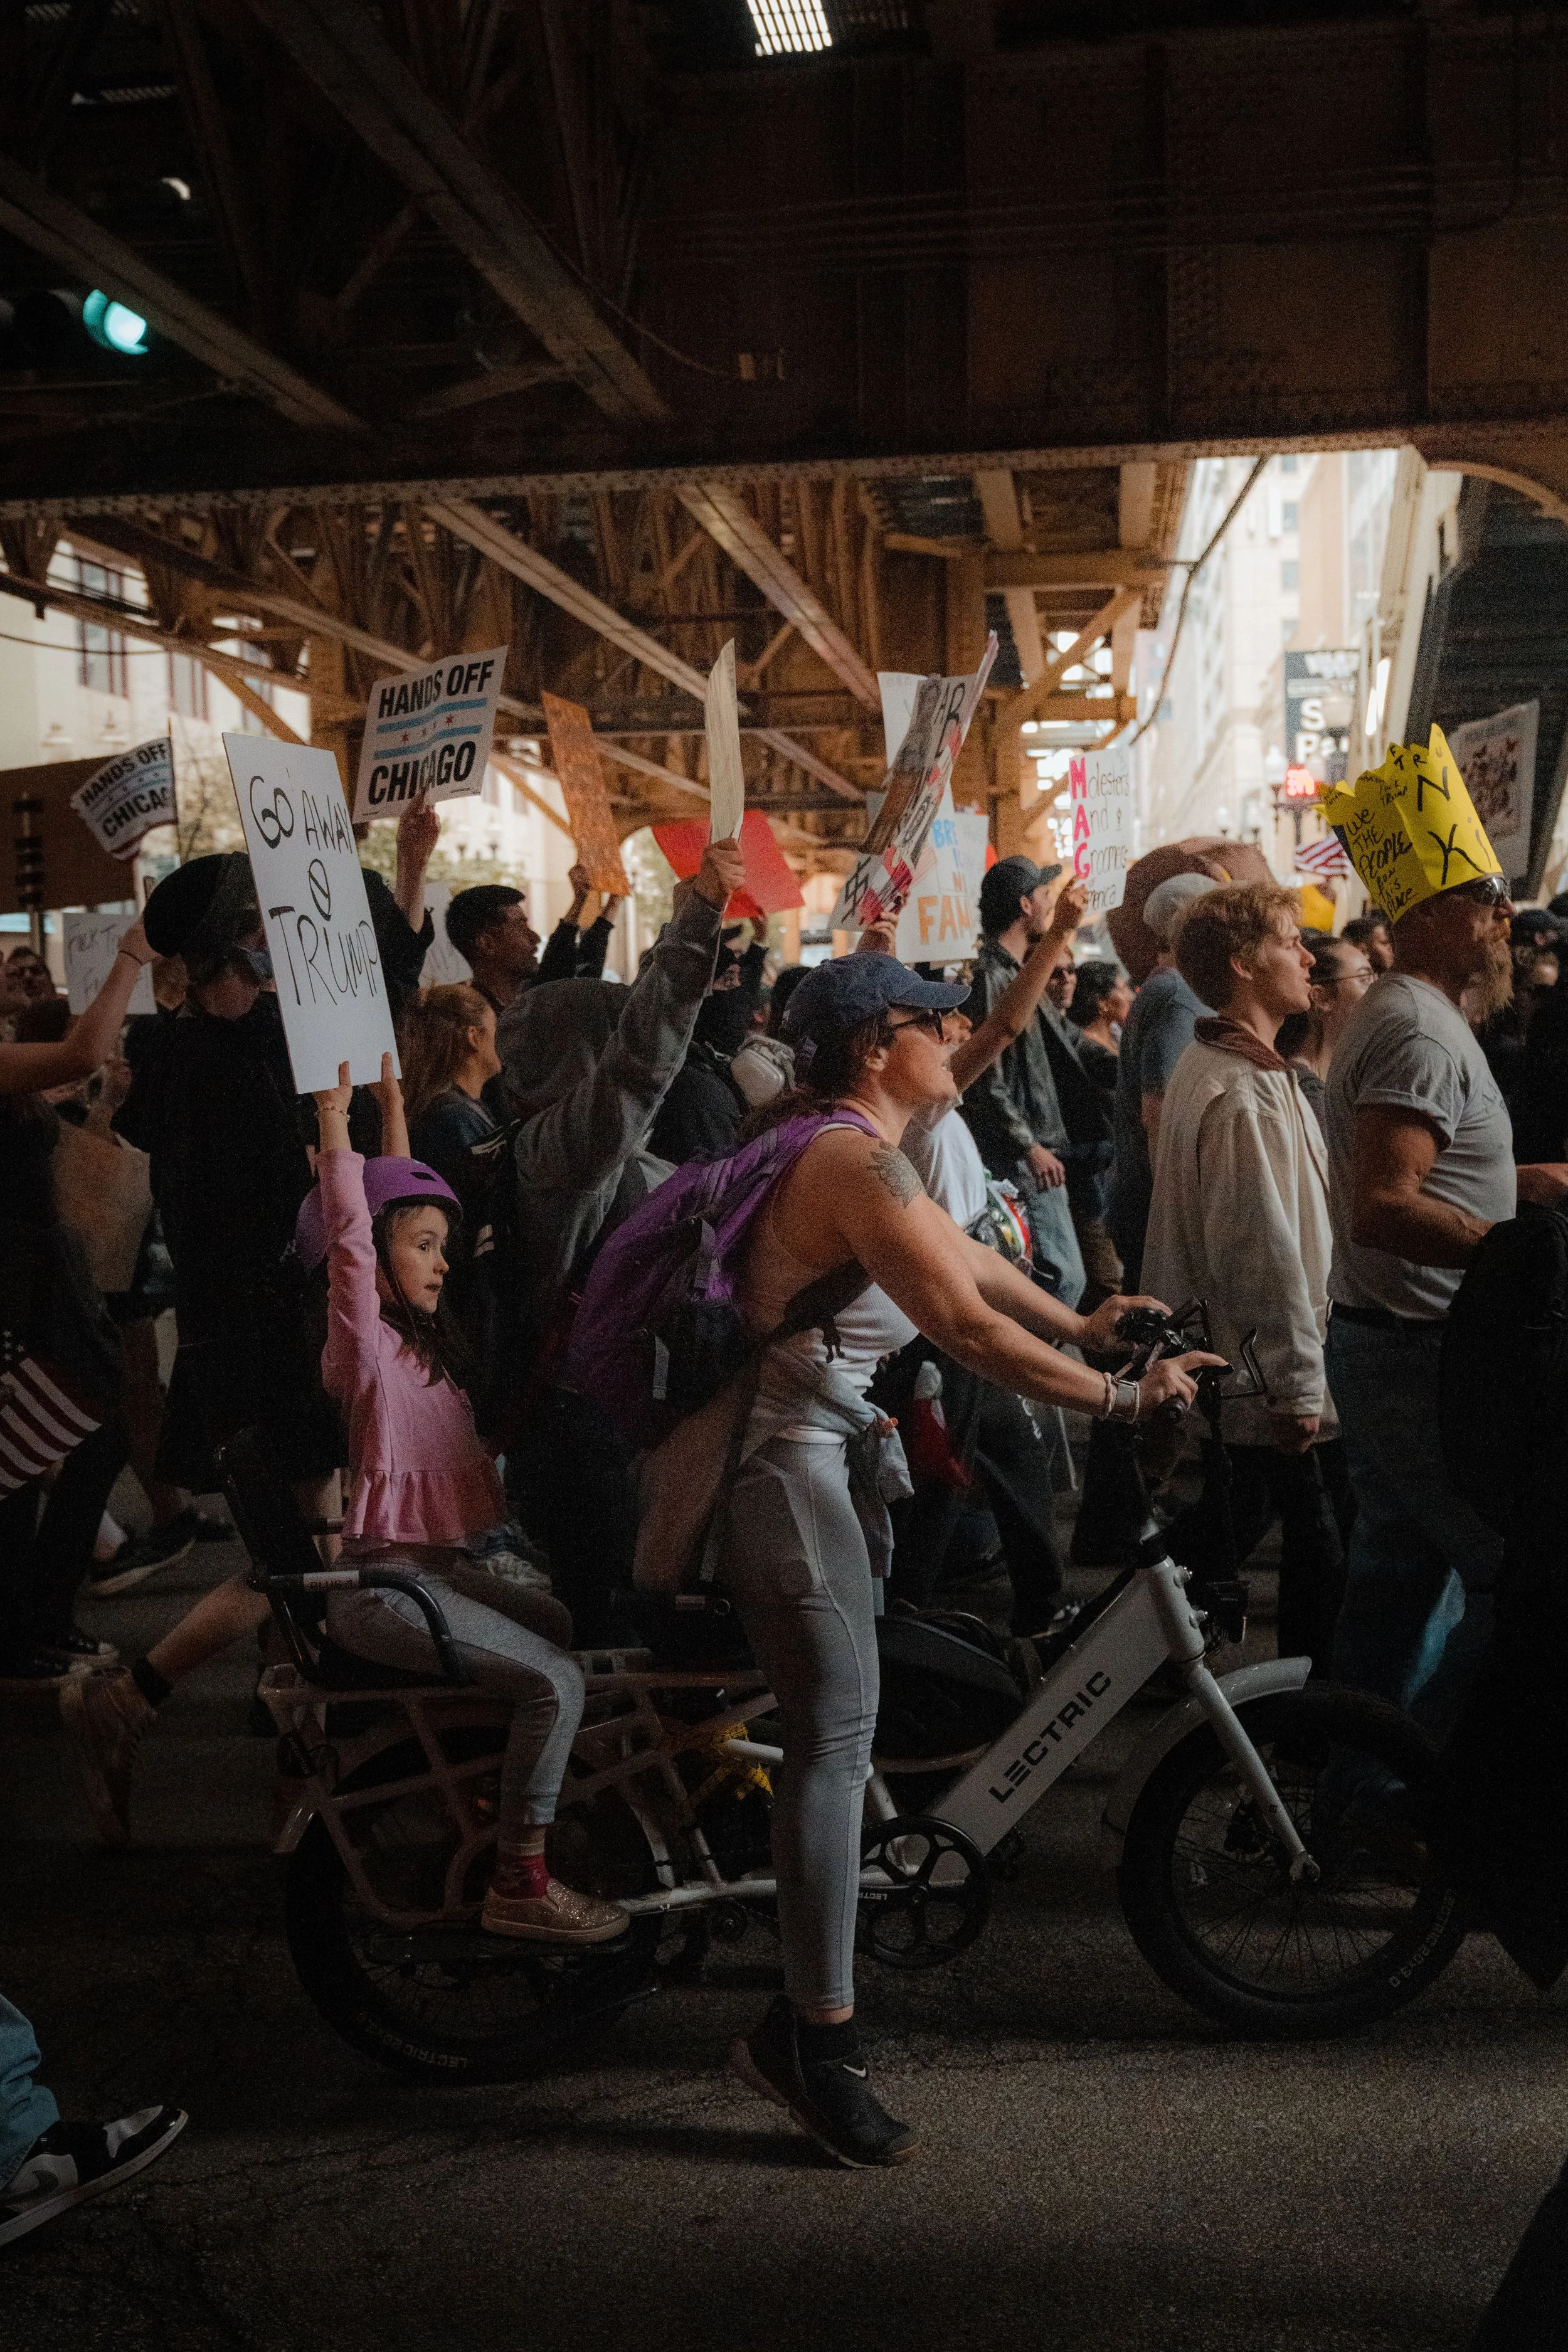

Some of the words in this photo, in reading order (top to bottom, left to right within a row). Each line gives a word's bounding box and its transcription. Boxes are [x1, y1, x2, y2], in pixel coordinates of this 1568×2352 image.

[378, 669, 442, 719] HANDS
[446, 659, 495, 697] OFF
[80, 758, 135, 807] HANDS
[137, 743, 166, 765] OFF
[368, 741, 477, 805] CHICAGO
[102, 787, 167, 837] CHICA
[250, 775, 295, 849] GO
[302, 790, 352, 854] AWAY
[1085, 883, 1116, 910] merica
[269, 906, 378, 1007] TRUMP
[989, 1671, 1111, 1803] LECTRIC
[402, 2043, 467, 2068] LECTRIC
